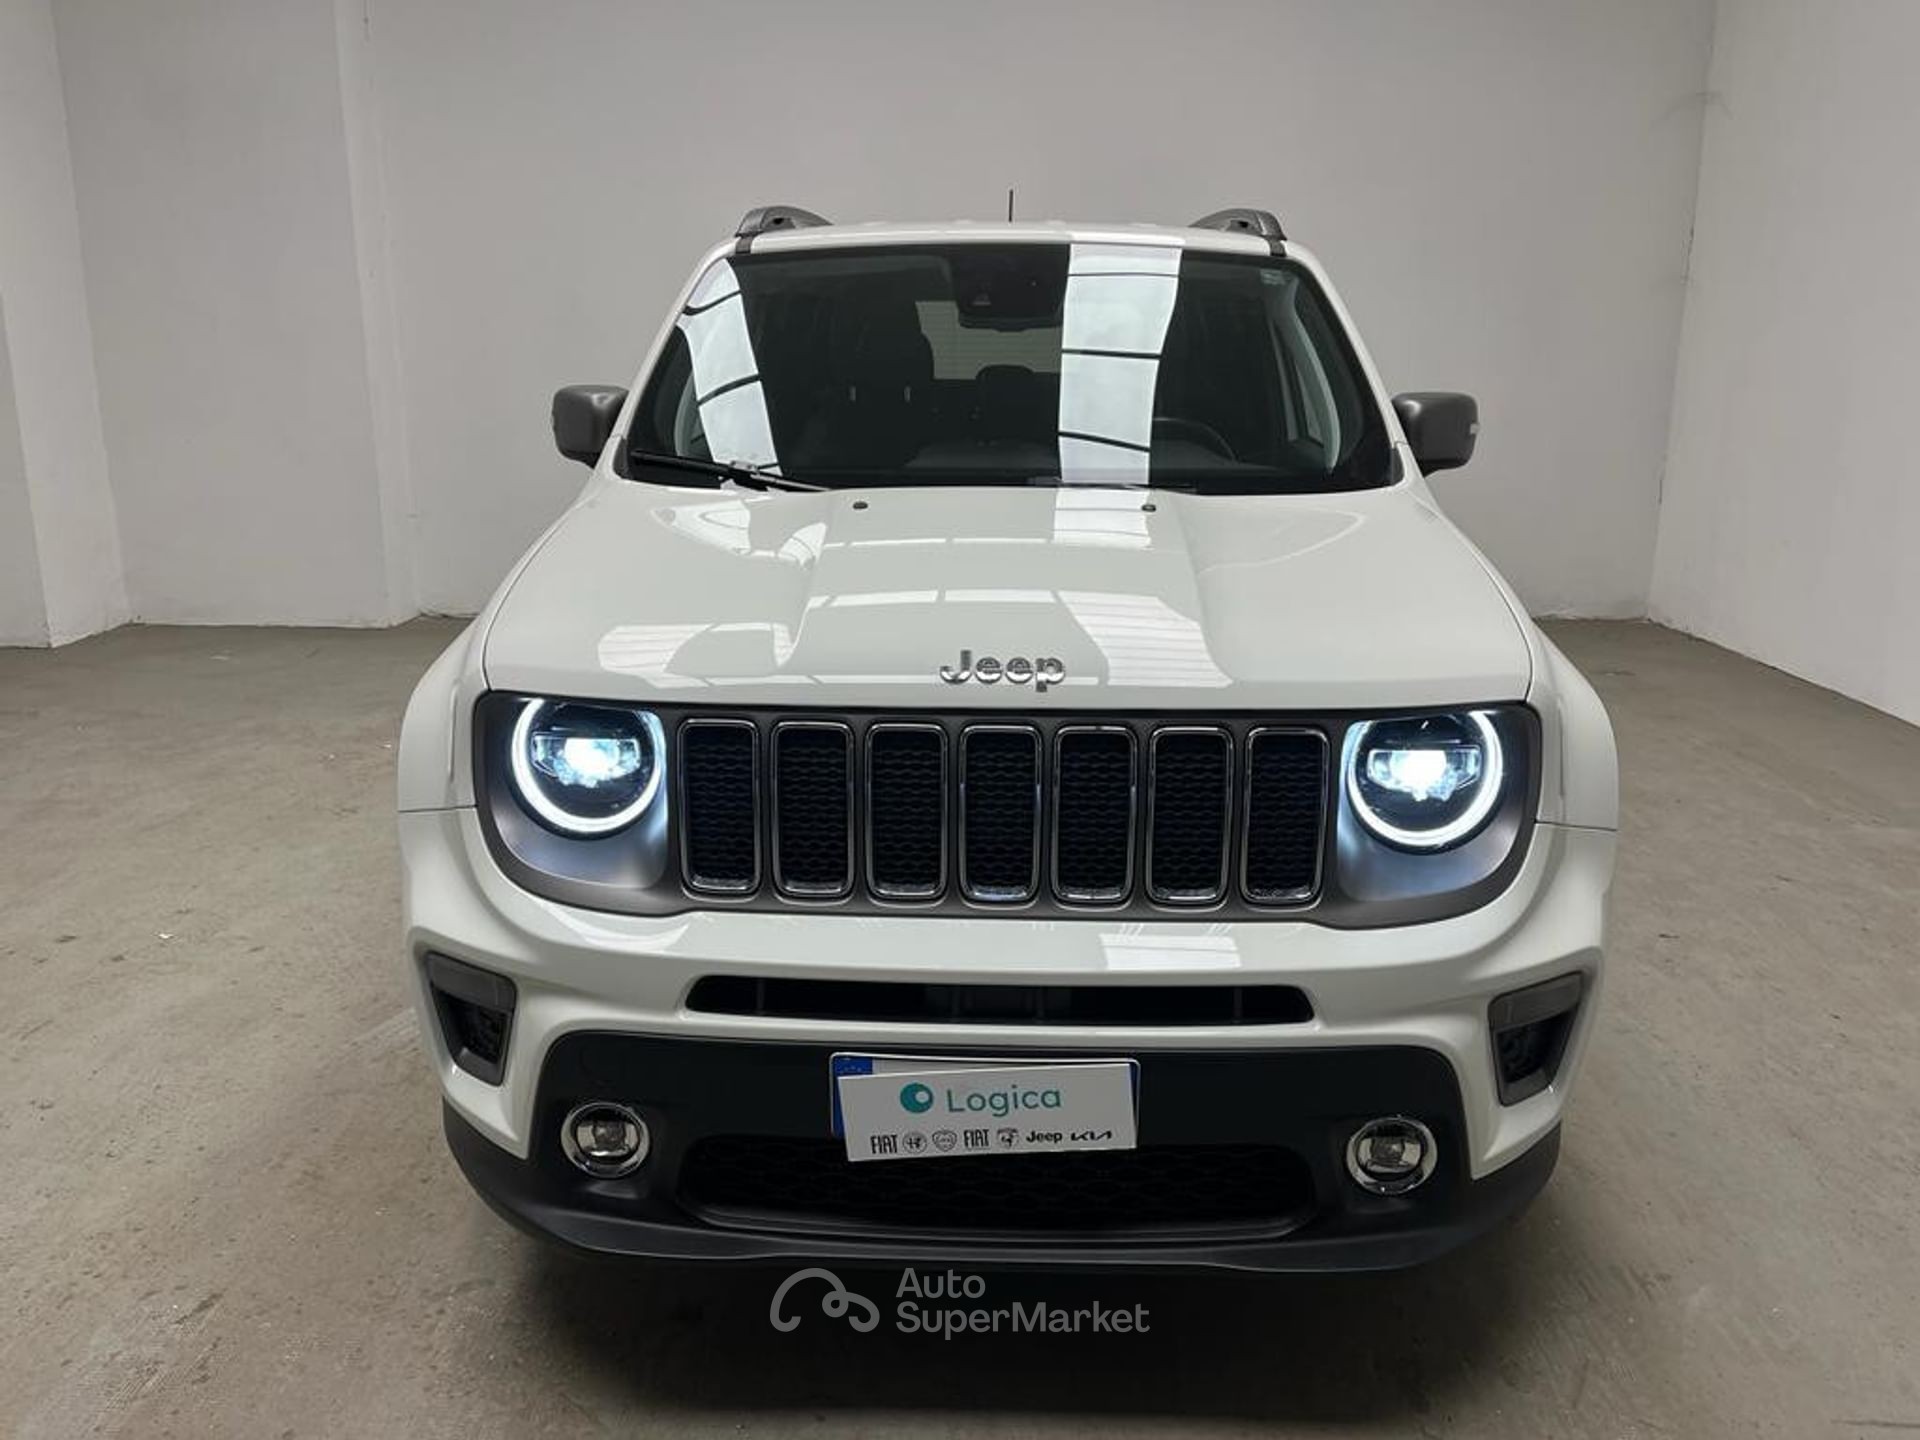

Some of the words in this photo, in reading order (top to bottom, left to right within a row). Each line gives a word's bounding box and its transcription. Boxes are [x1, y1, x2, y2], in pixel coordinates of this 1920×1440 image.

[939, 650, 1066, 692] Jeep
[947, 1084, 1061, 1117] Logica
[870, 1133, 898, 1155] FIAT
[963, 1129, 989, 1148] FIAT
[1026, 1130, 1062, 1144] Jeep
